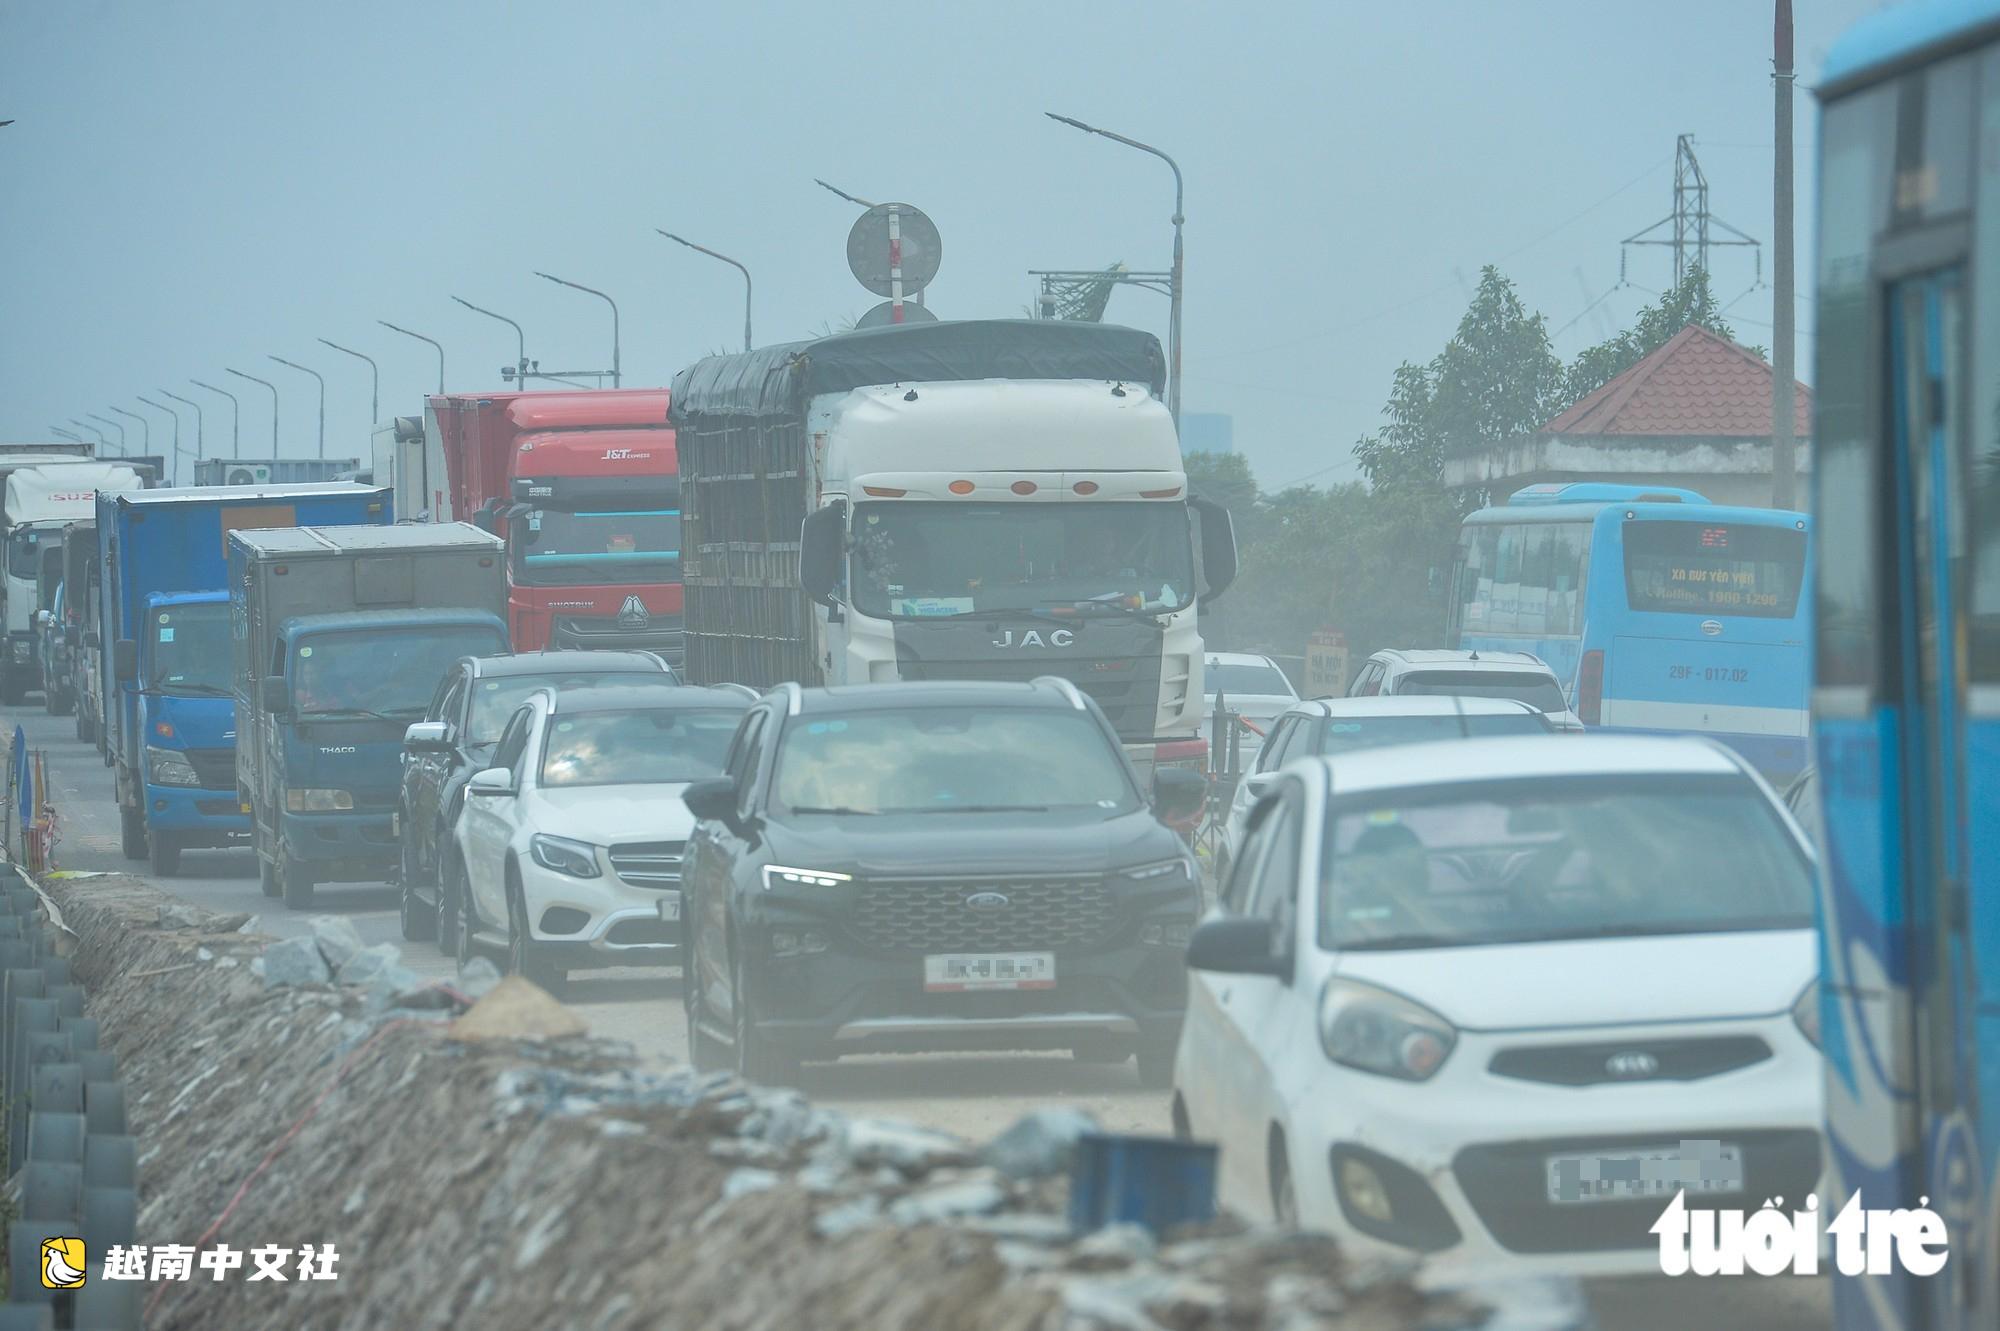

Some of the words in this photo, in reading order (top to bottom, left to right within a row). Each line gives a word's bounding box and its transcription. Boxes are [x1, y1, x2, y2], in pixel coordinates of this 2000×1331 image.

[601, 449, 631, 460] J&T
[1689, 569, 1707, 582] BUS
[992, 629, 1074, 648] JAC
[1669, 665, 1692, 680] 29F
[1705, 667, 1749, 682] 017.02
